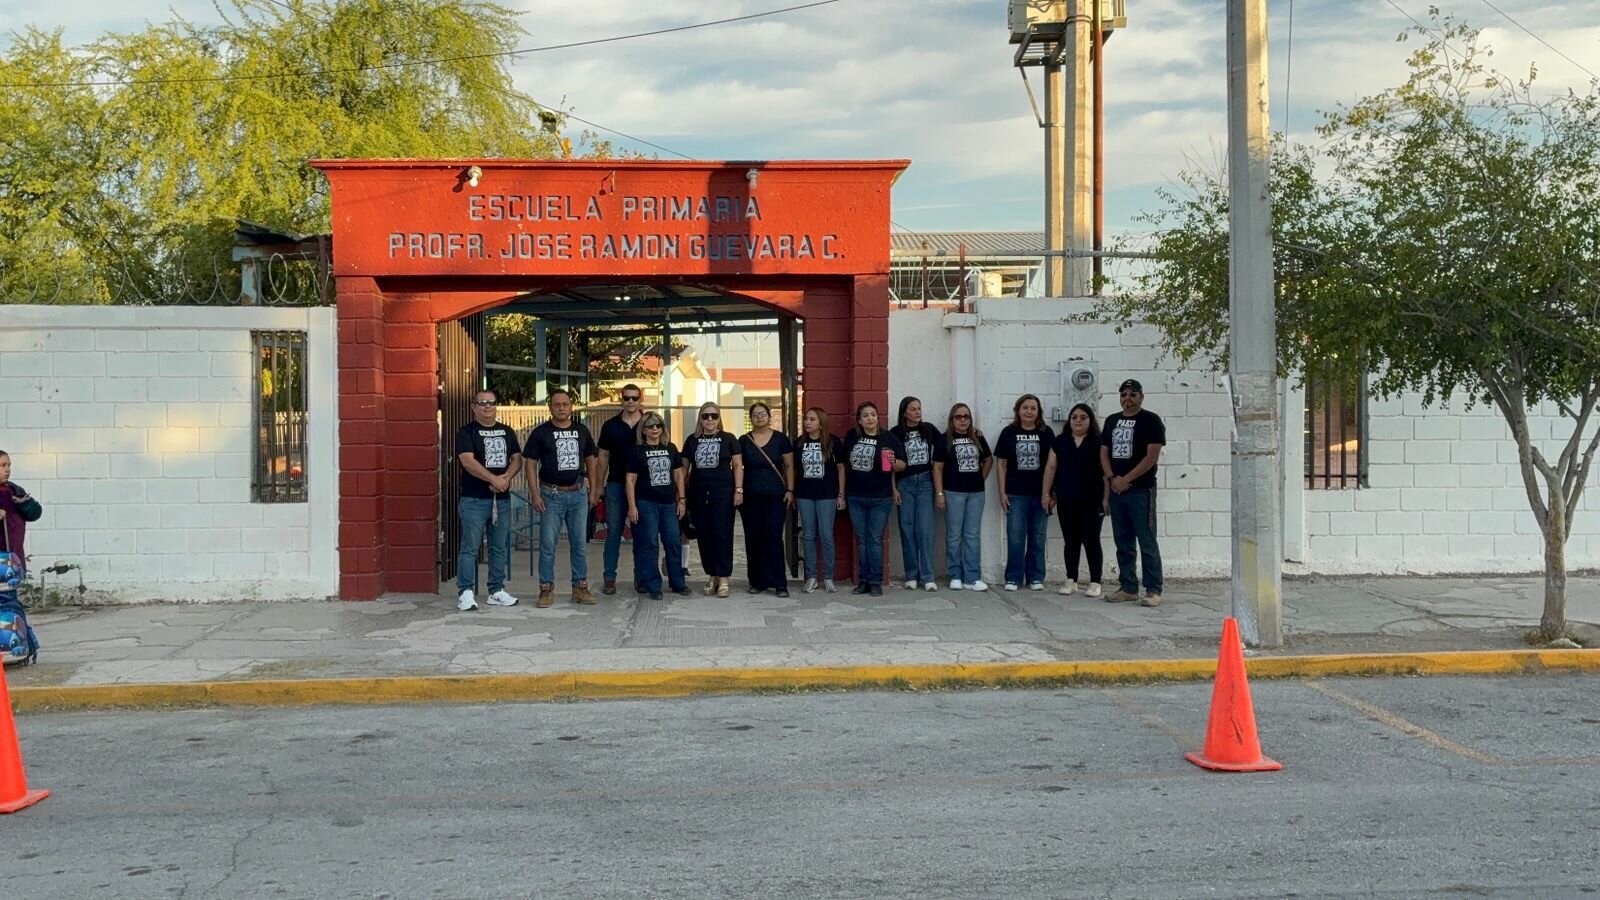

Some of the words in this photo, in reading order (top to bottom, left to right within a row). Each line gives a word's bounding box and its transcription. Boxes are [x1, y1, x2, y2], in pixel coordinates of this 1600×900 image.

[469, 195, 603, 221] ESCUELA
[623, 196, 762, 221] PRIMARIA
[389, 232, 492, 259] PROFR.
[501, 233, 572, 259] JOSE
[580, 234, 680, 260] RAMON
[689, 234, 816, 260] GUEVARA
[822, 234, 845, 260] C.
[1116, 420, 1137, 428] PAKO
[553, 431, 579, 439] PABLO
[1112, 444, 1133, 458] 23
[486, 453, 507, 468] 23
[558, 454, 579, 471] 23
[696, 455, 719, 469] 23
[851, 459, 874, 472] 23
[908, 451, 929, 466] 23
[958, 458, 980, 472] 23
[1018, 456, 1039, 470] 23
[804, 464, 825, 478] 23
[651, 472, 671, 486] 23
